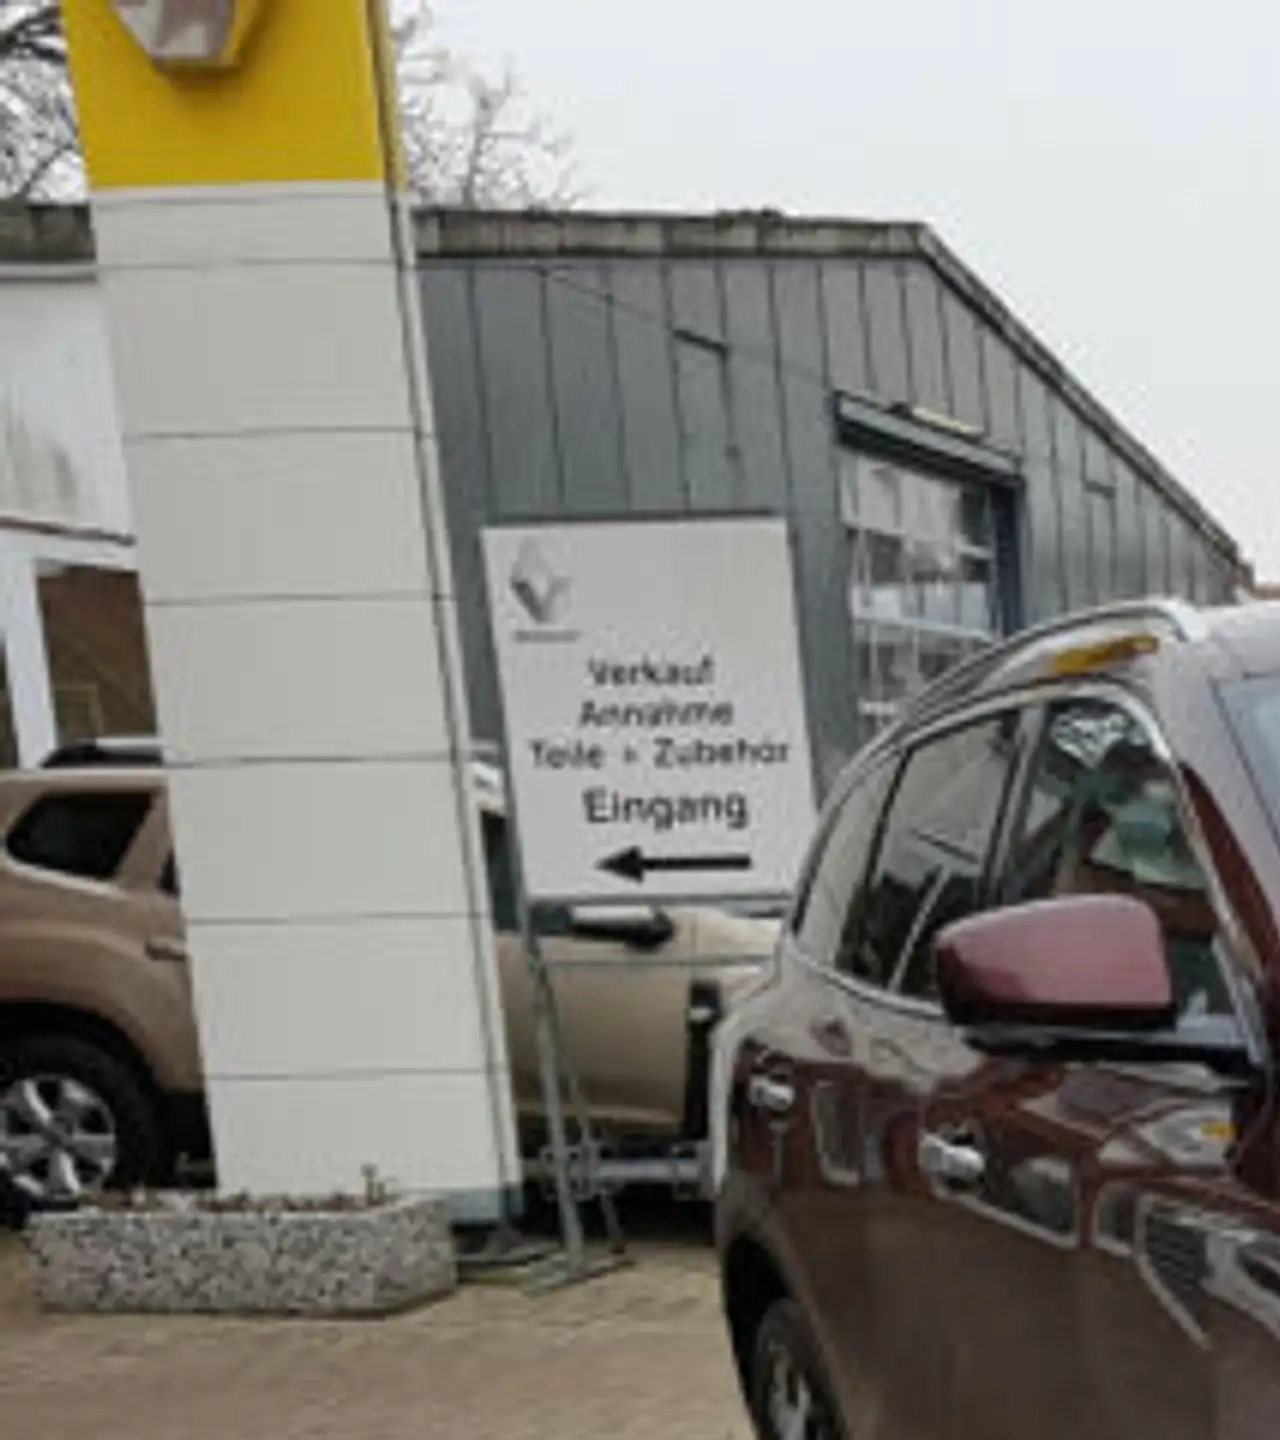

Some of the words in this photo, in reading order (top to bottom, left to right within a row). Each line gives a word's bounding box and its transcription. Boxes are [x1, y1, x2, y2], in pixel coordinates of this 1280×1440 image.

[588, 655, 714, 686] Verkauf
[580, 696, 733, 728] Annahme
[529, 740, 605, 769] Teile
[583, 789, 748, 830] Eingang
